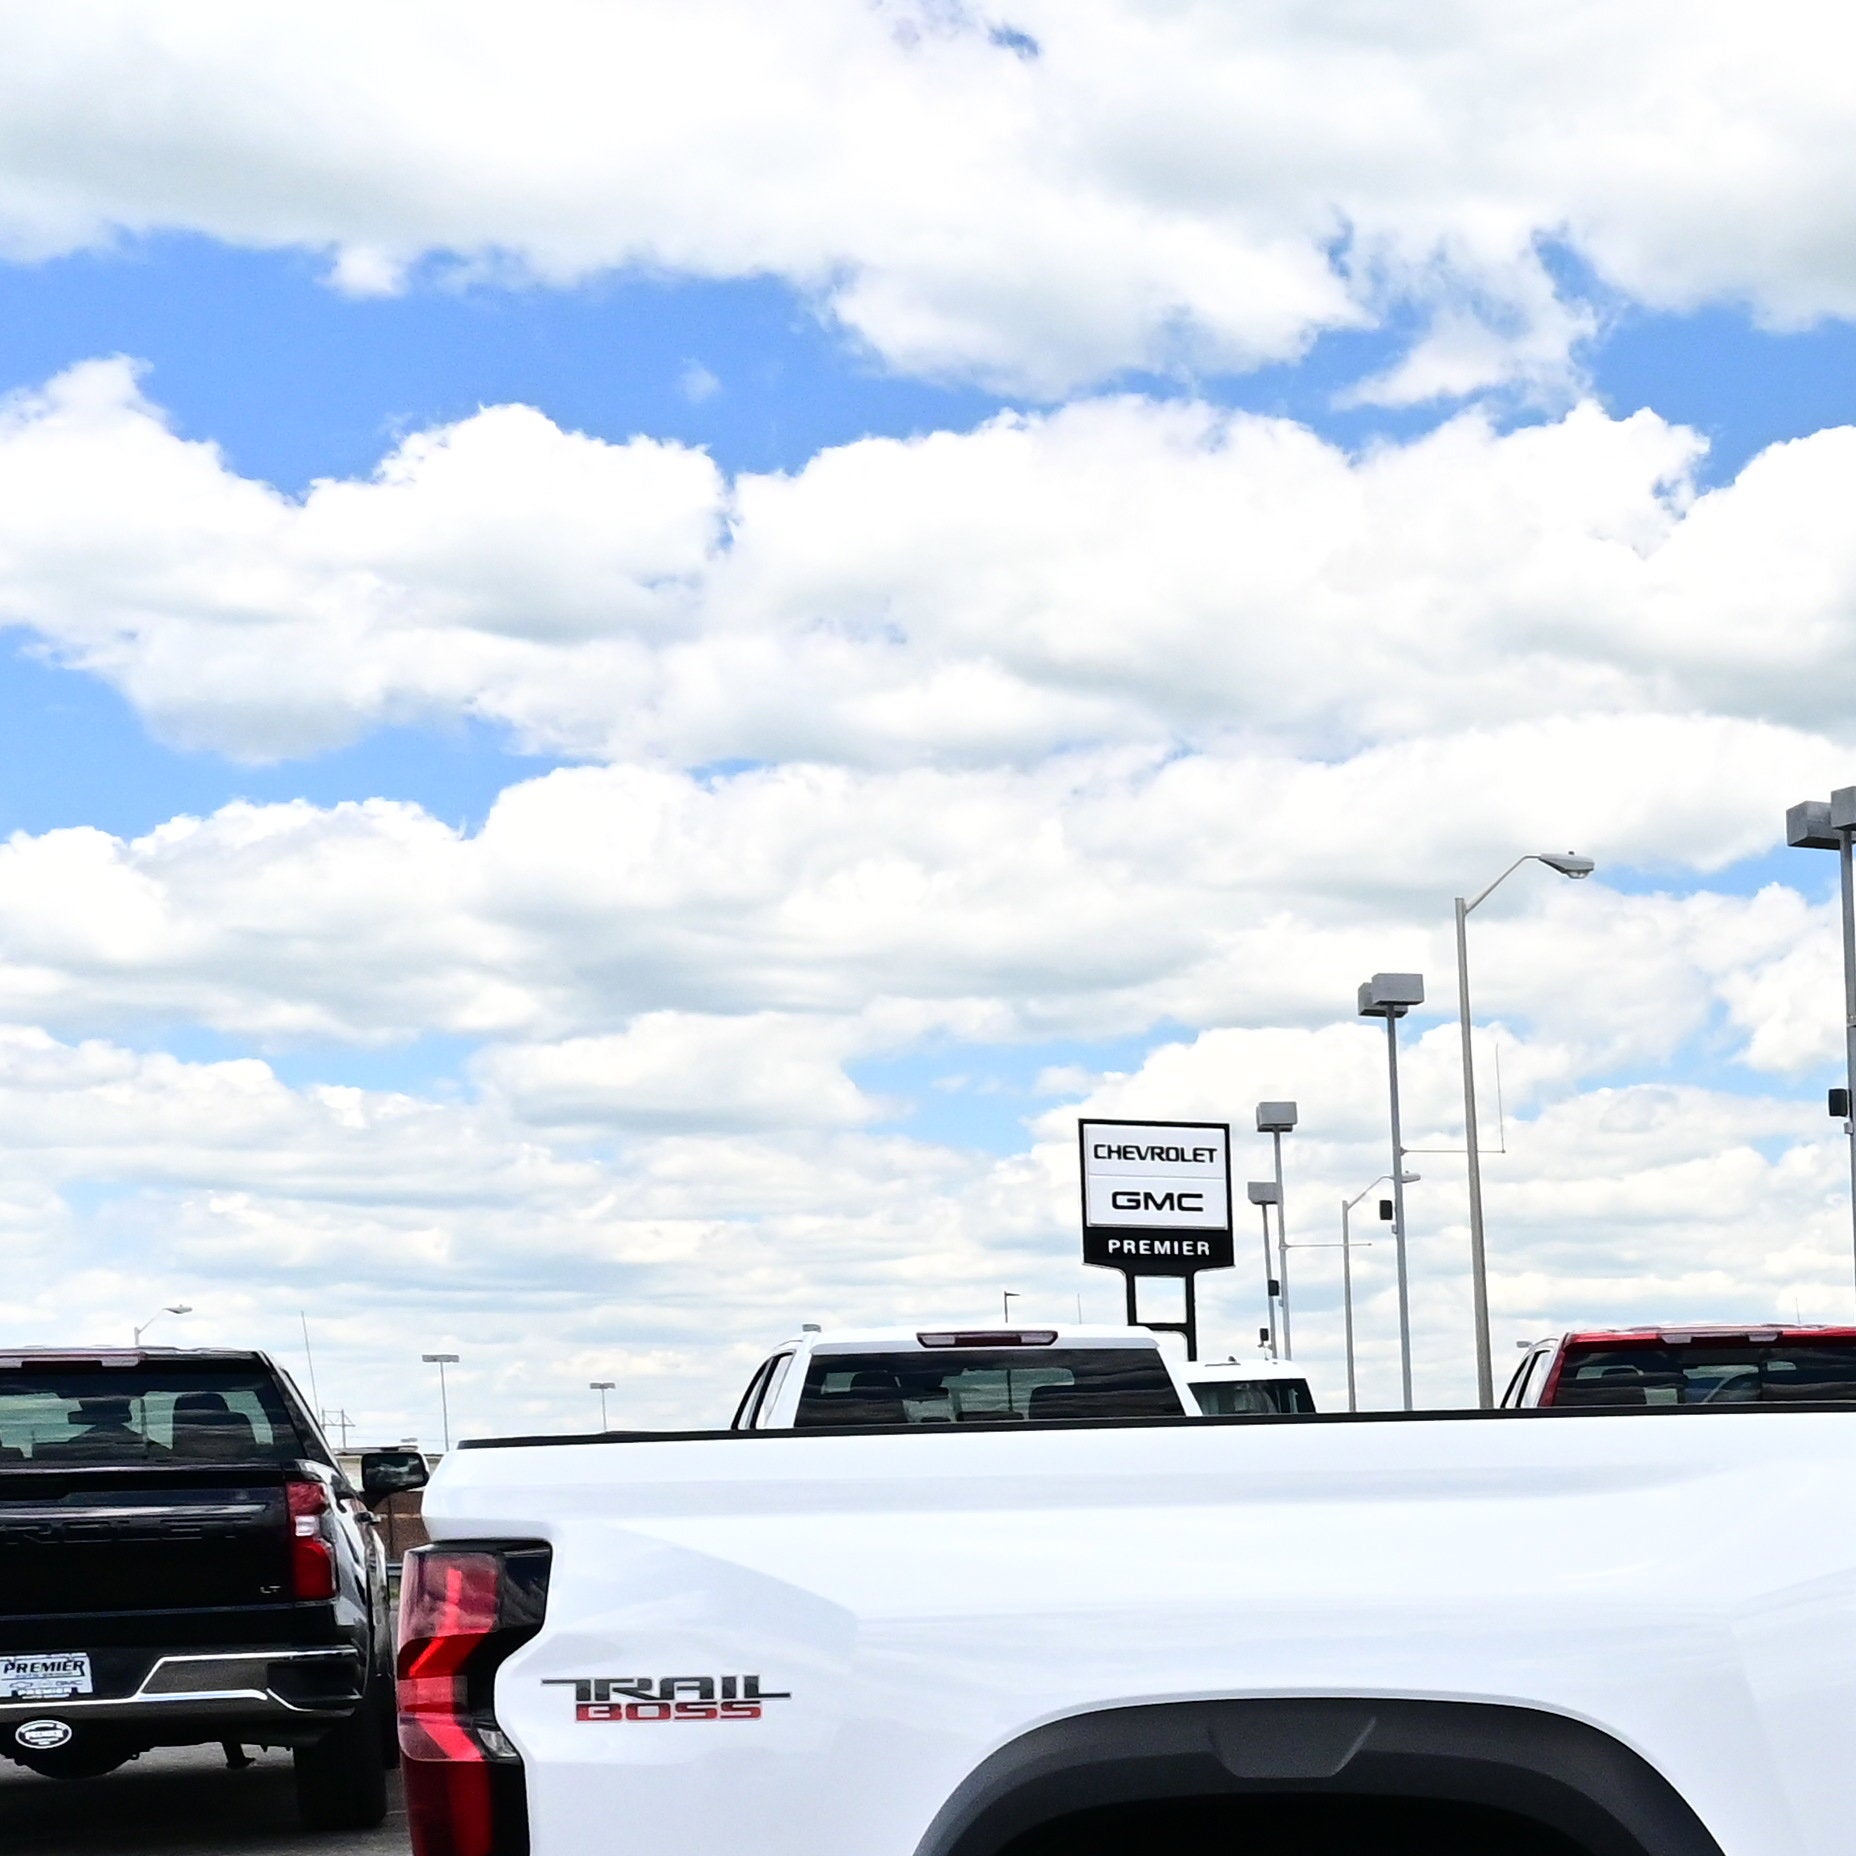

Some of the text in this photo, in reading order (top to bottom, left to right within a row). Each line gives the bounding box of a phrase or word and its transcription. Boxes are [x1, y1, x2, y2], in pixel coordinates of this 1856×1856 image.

[1093, 1143, 1218, 1164] CHEVROLET
[1111, 1190, 1204, 1212] GMC
[1107, 1239, 1210, 1256] PREMIER
[3, 1659, 85, 1677] PREMIER
[541, 1674, 791, 1702] TRAIL
[575, 1700, 762, 1723] BOSS
